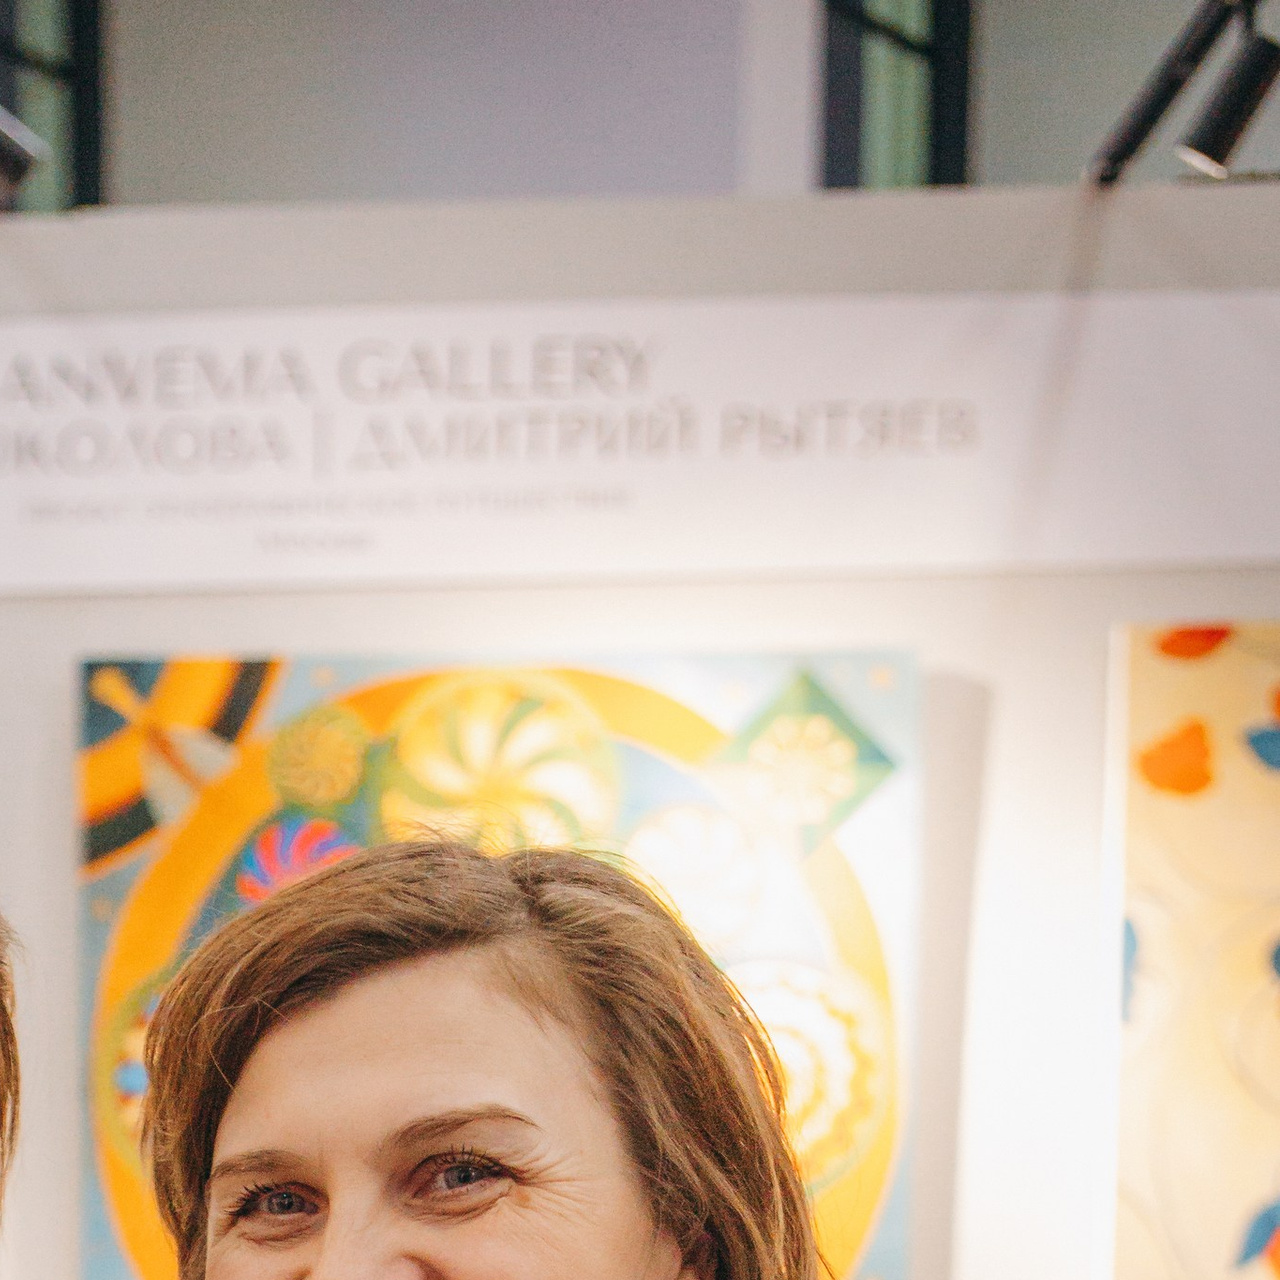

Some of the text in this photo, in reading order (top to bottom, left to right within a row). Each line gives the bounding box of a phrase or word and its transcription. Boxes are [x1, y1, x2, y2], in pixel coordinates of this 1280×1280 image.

[335, 332, 658, 404] GALLERY
[346, 396, 697, 472] ДМИТРИЙ
[718, 398, 982, 460] РЫТЯЕВ
